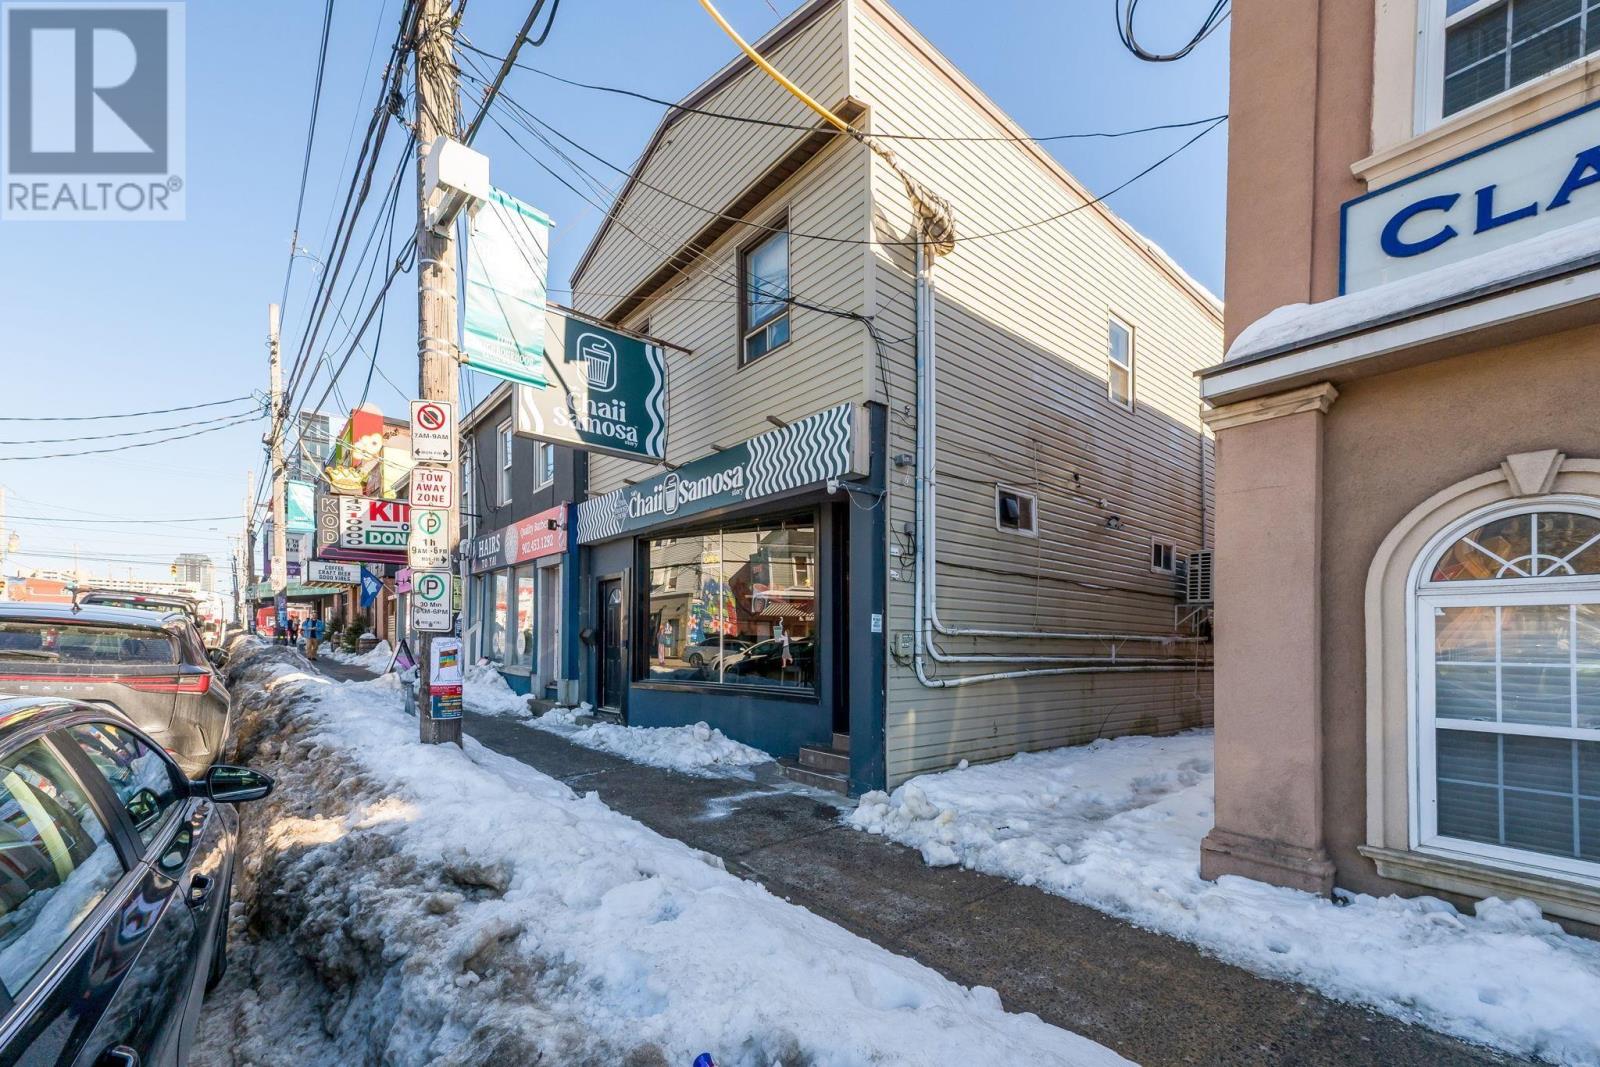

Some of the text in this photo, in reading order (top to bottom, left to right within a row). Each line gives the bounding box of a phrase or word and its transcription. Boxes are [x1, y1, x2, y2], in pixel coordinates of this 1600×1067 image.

[566, 391, 626, 423] Chaii
[414, 432, 449, 440] 7AM-9AM
[420, 473, 444, 482] TOW
[416, 483, 447, 493] AWAY
[628, 484, 663, 518] Chaii
[679, 465, 745, 504] Samosa
[417, 493, 445, 503] ZONE
[478, 533, 500, 558] HAIRS
